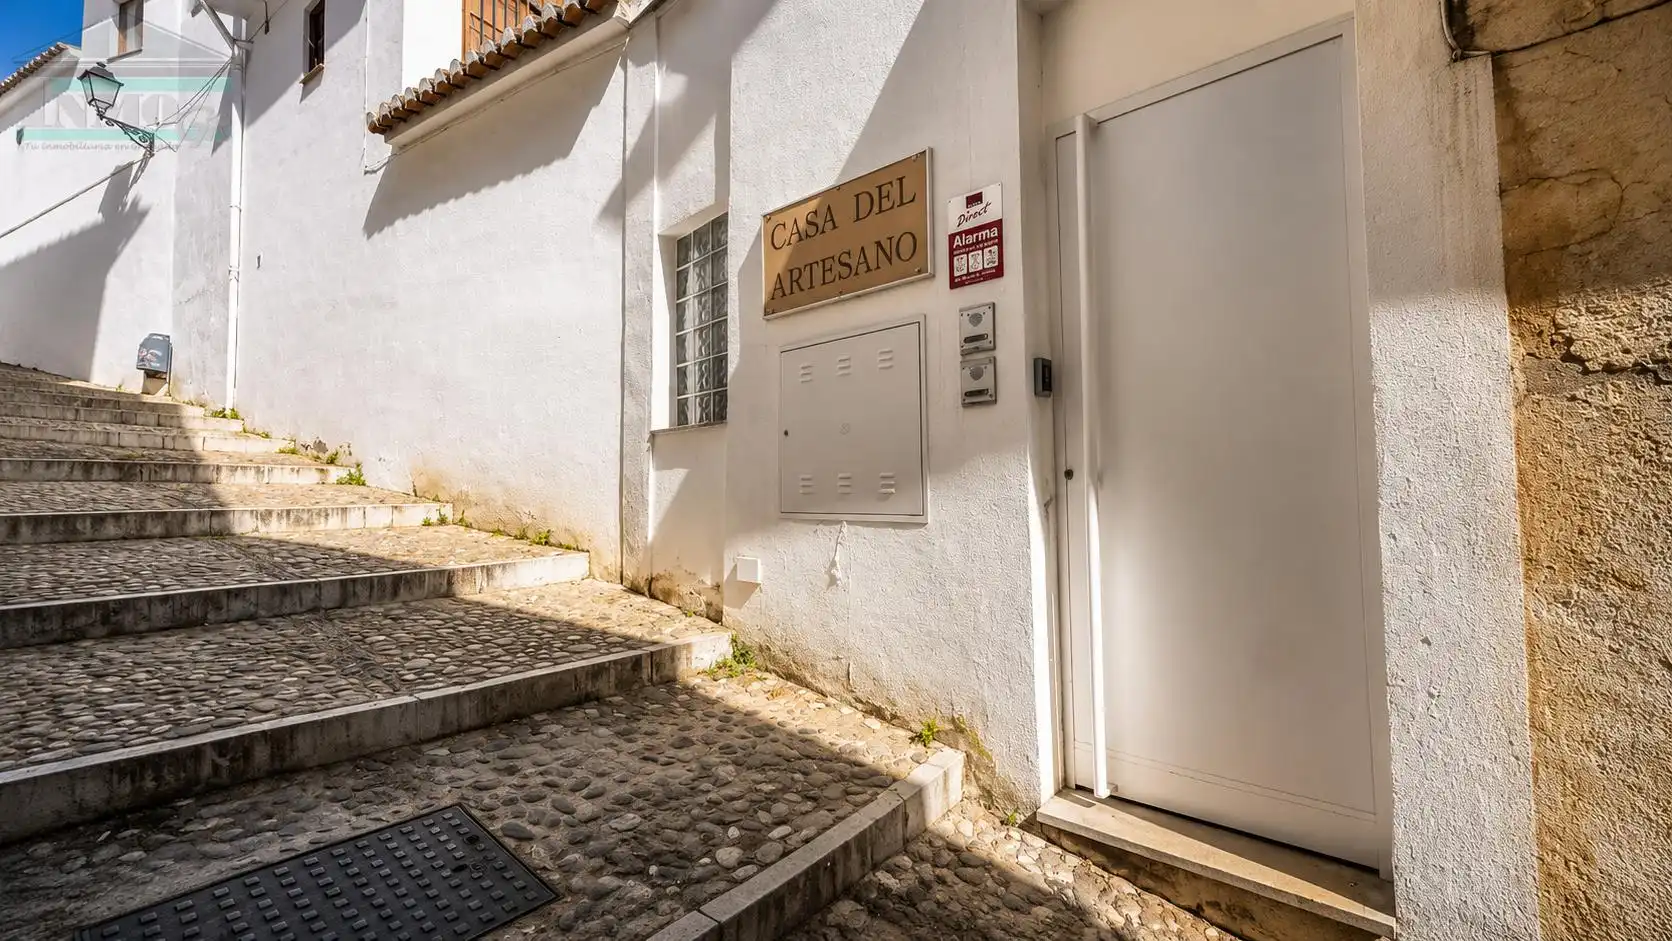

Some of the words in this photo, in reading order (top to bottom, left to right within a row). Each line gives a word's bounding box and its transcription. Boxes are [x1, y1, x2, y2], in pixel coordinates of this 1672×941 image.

[770, 203, 840, 251] CASA
[852, 175, 917, 223] DEL
[953, 226, 998, 249] Alarma
[957, 200, 992, 228] Direct
[770, 231, 918, 301] ARTESANO
